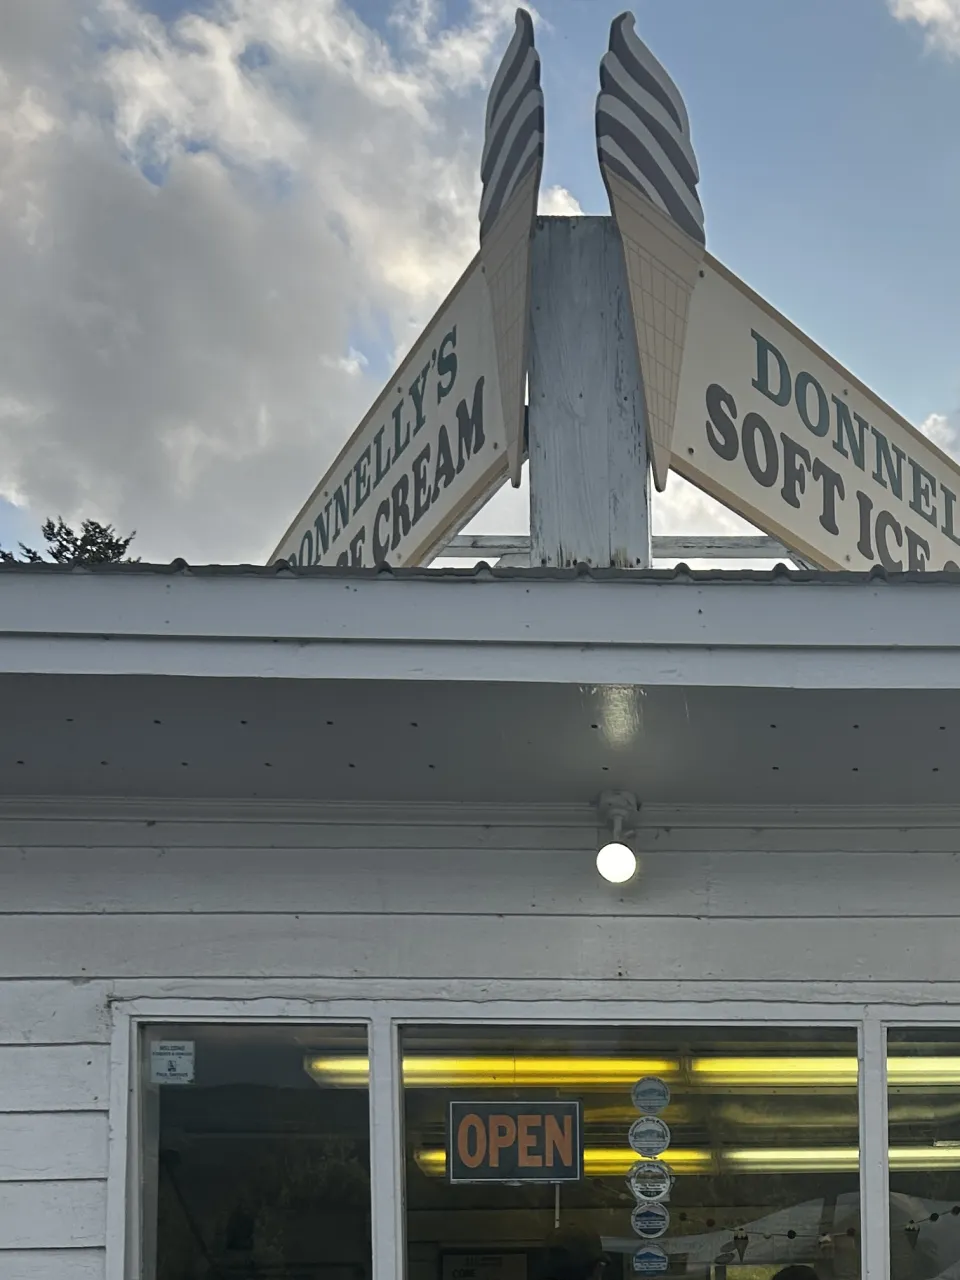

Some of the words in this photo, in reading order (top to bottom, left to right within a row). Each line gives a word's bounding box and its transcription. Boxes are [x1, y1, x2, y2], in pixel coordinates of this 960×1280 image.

[287, 325, 457, 567] ONNELLY'S
[372, 376, 486, 567] CREAM
[705, 383, 845, 536] SOFT
[856, 490, 931, 572] ICE
[457, 1113, 573, 1168] OPEN
